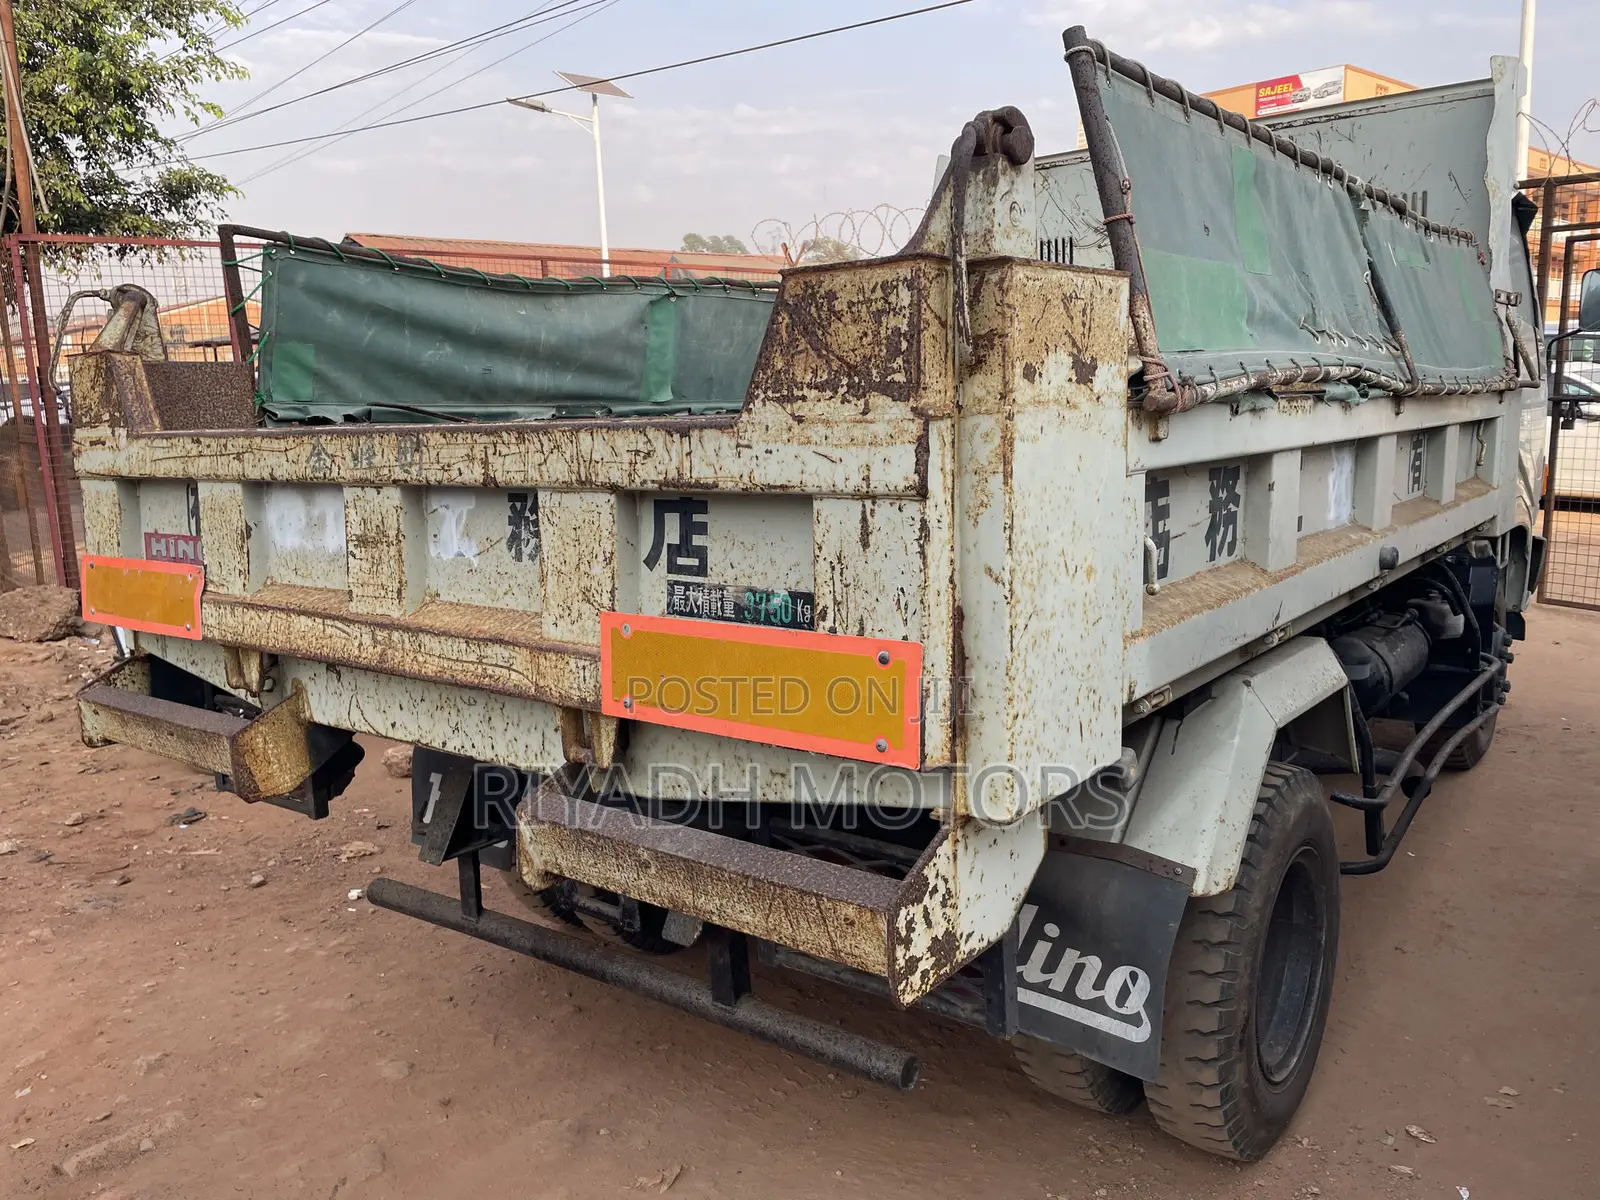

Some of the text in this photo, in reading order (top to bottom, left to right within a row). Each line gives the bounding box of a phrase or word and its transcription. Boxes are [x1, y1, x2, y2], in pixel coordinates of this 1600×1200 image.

[1258, 82, 1294, 98] SAJEEL
[151, 537, 204, 562] HIN
[642, 496, 709, 578] 店
